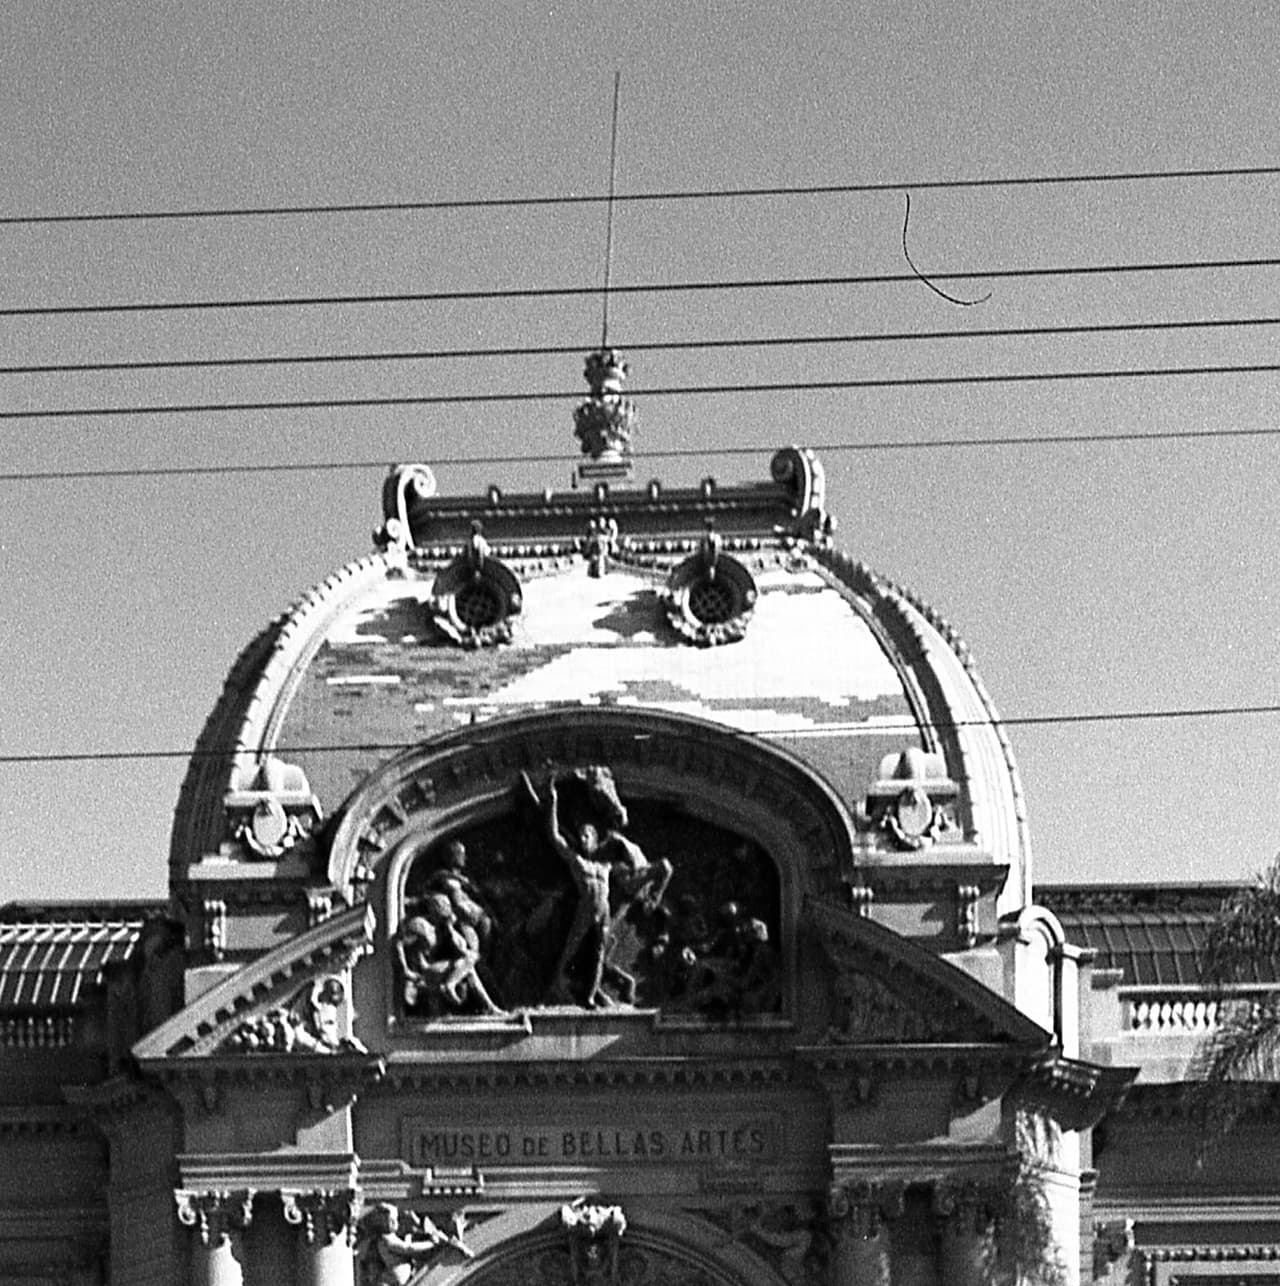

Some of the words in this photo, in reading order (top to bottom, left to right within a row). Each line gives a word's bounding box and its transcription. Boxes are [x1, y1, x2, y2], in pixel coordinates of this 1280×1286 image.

[420, 1131, 511, 1158] MUSEO
[522, 1136, 550, 1157] DE
[562, 1131, 664, 1156] BELLAS
[681, 1129, 766, 1154] ARTES
